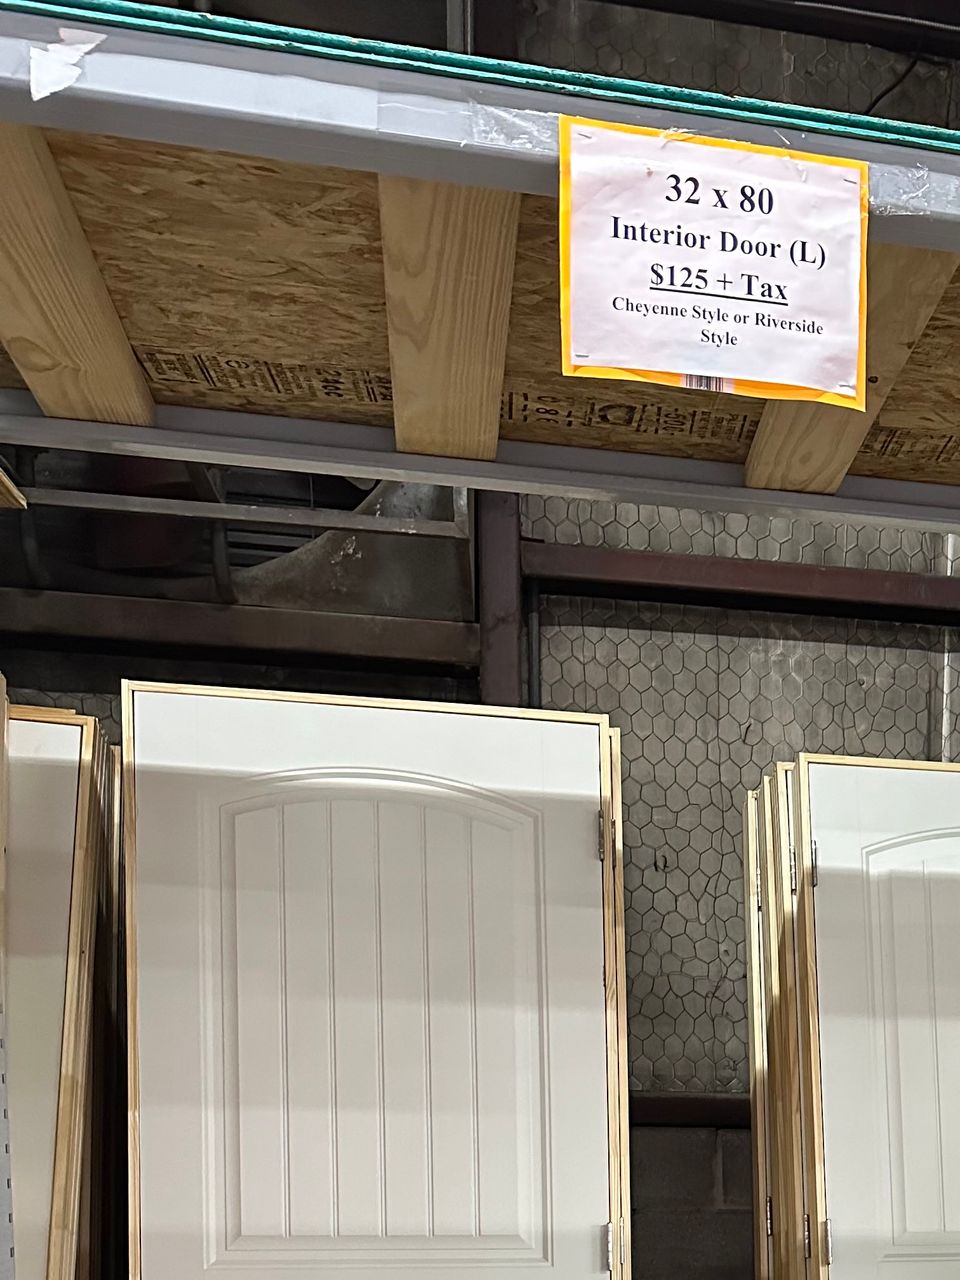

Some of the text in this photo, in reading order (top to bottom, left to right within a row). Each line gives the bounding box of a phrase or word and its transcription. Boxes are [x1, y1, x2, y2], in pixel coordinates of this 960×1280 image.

[665, 174, 774, 214] 32 x 80
[610, 216, 826, 271] Interior Door (L)
[650, 263, 788, 301] $125 + Tax
[612, 296, 824, 335] Cheyenne Style or Riverside
[700, 329, 737, 348] Style
